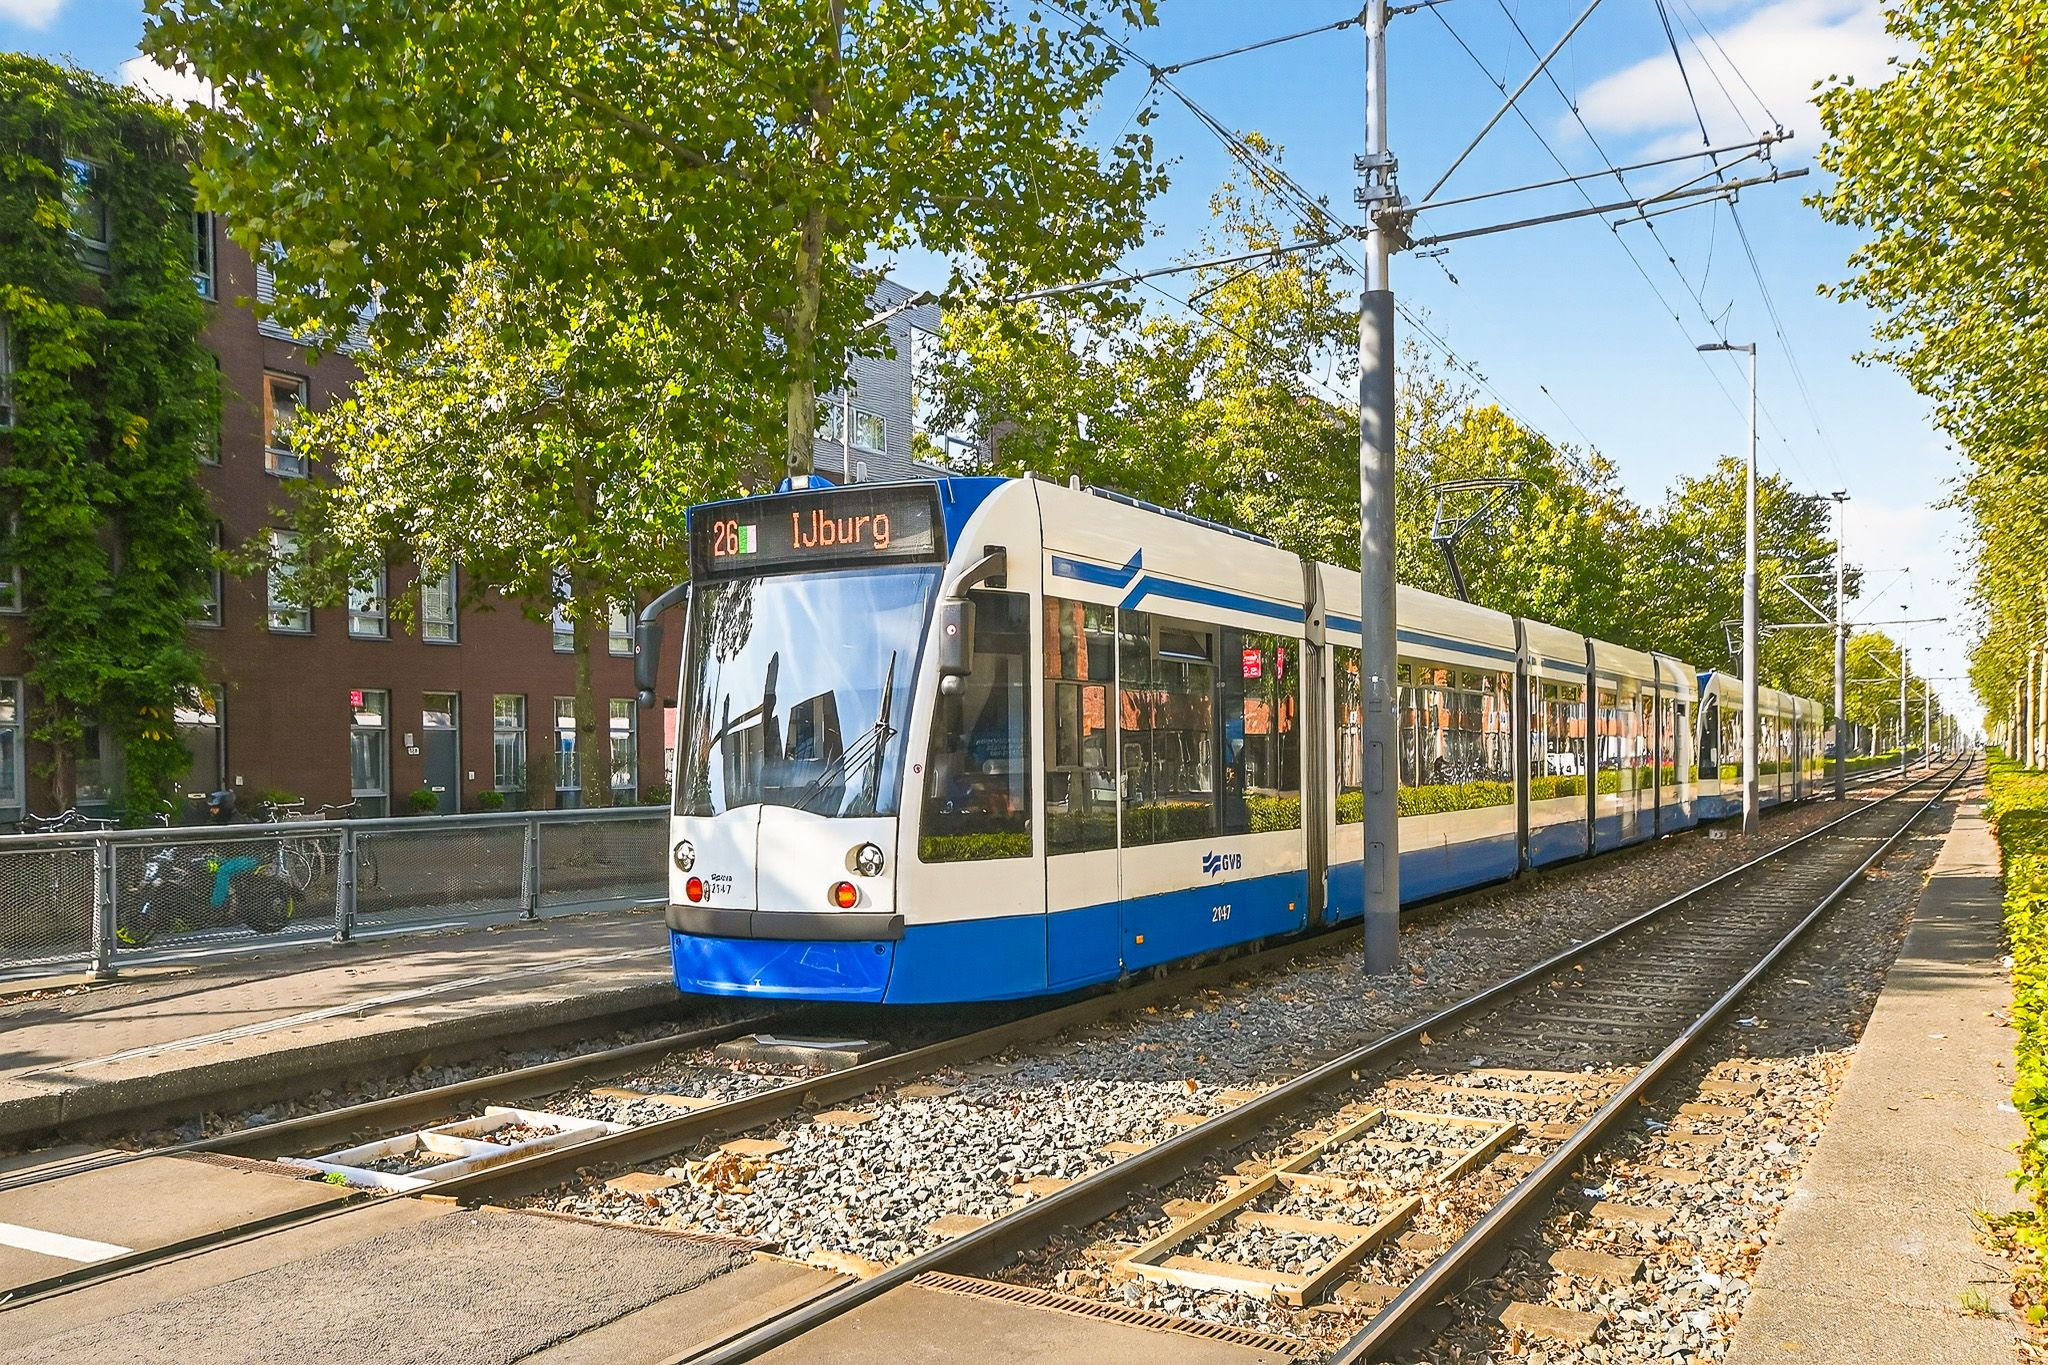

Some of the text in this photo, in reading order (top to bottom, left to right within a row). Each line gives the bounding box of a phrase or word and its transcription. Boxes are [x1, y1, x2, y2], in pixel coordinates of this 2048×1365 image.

[713, 509, 890, 557] 26 IJburg
[1222, 853, 1242, 870] GVB
[1211, 904, 1232, 922] 2147
